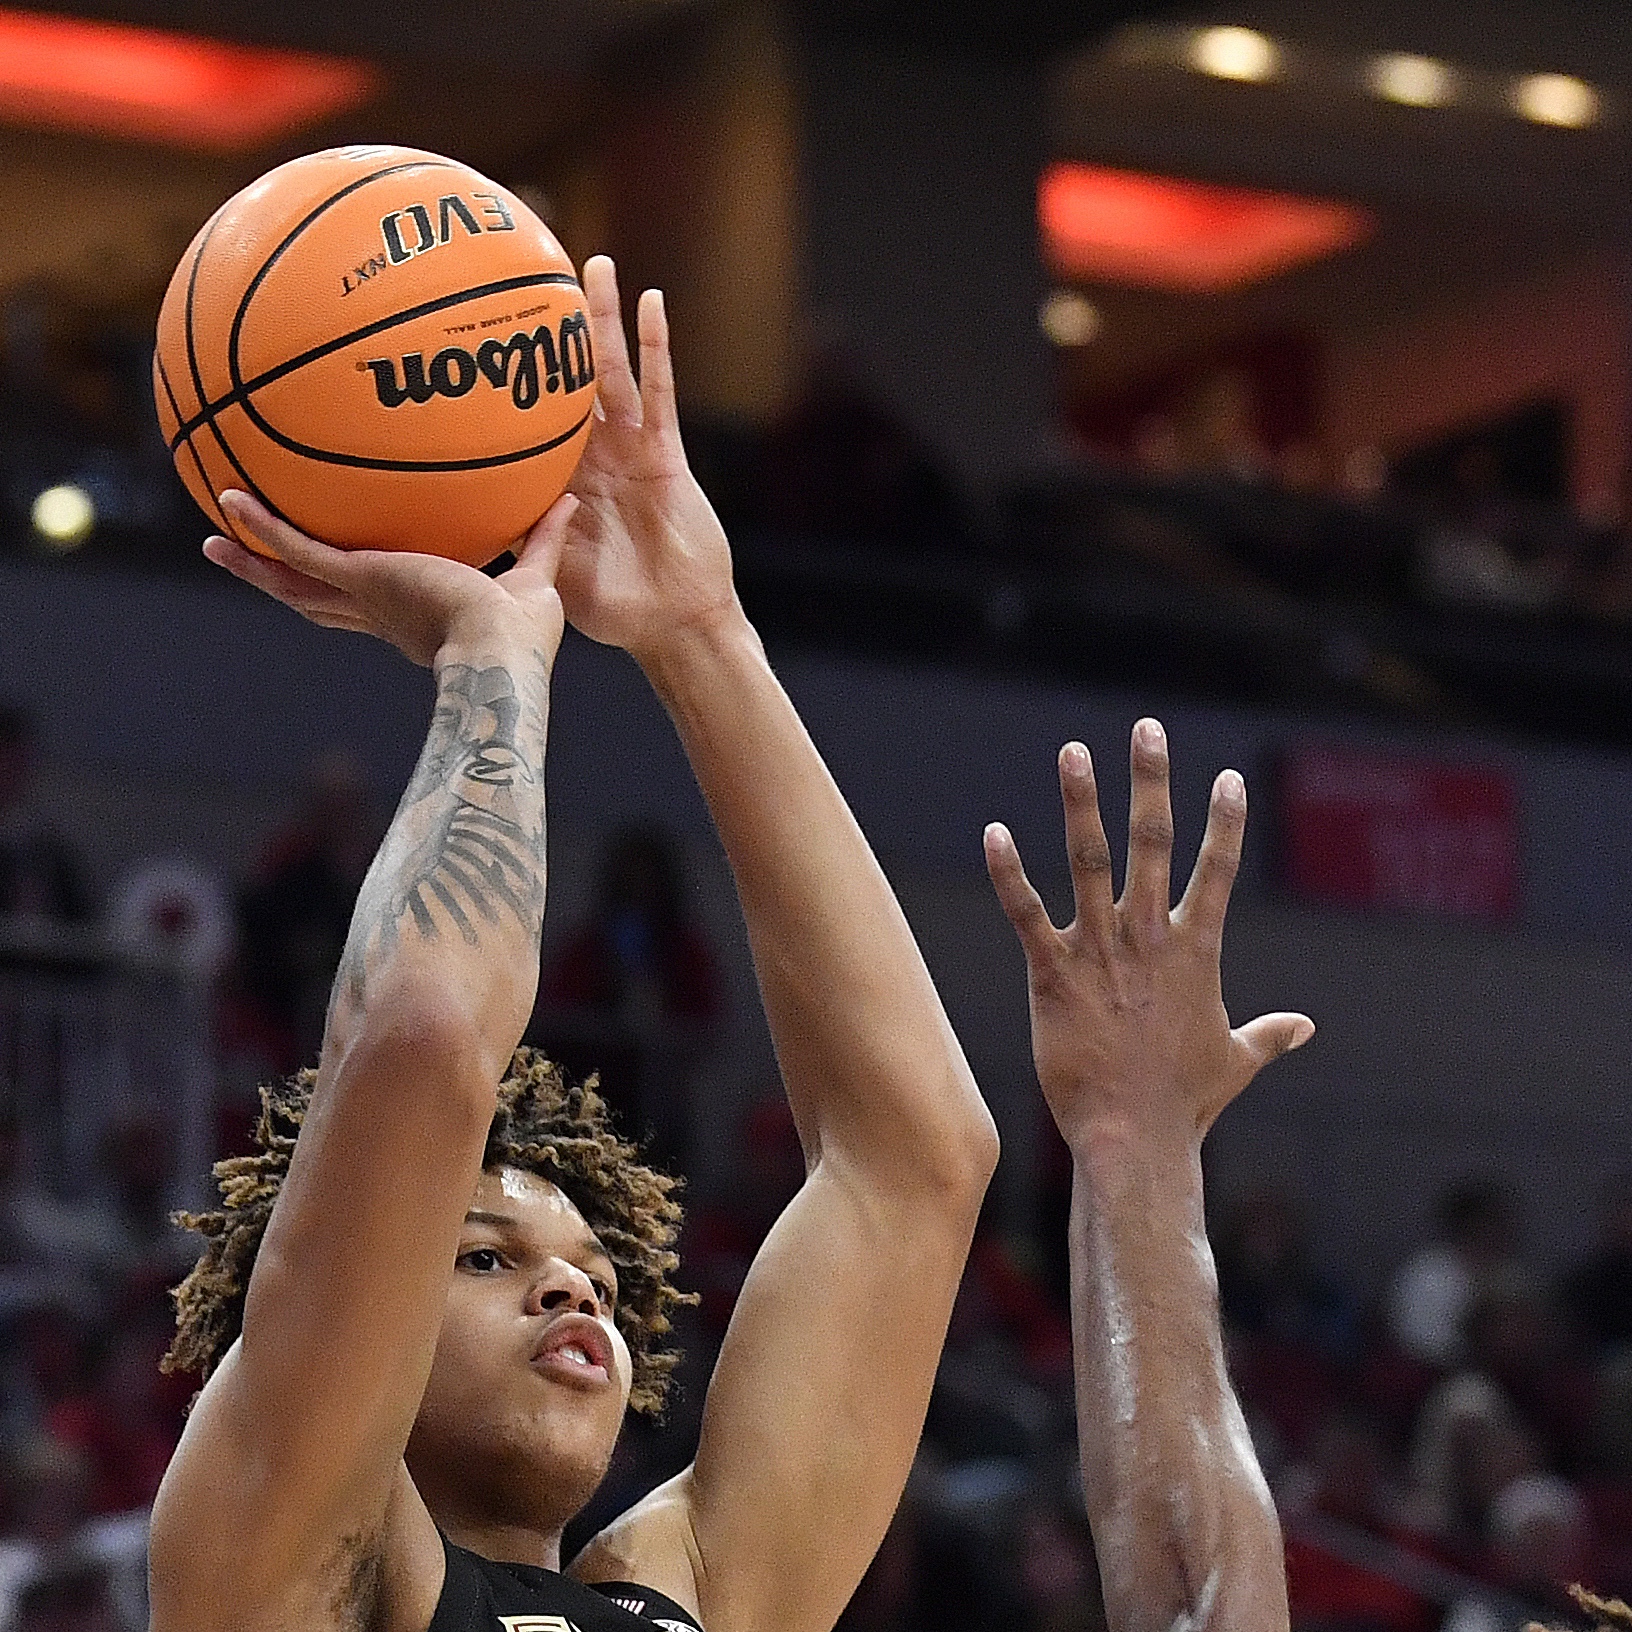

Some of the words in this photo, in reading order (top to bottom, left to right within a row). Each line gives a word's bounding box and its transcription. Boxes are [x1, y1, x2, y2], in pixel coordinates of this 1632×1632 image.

[379, 193, 516, 266] EVO
[340, 254, 386, 298] NXT
[443, 323, 477, 336] BALL
[365, 308, 596, 411] Wilson
